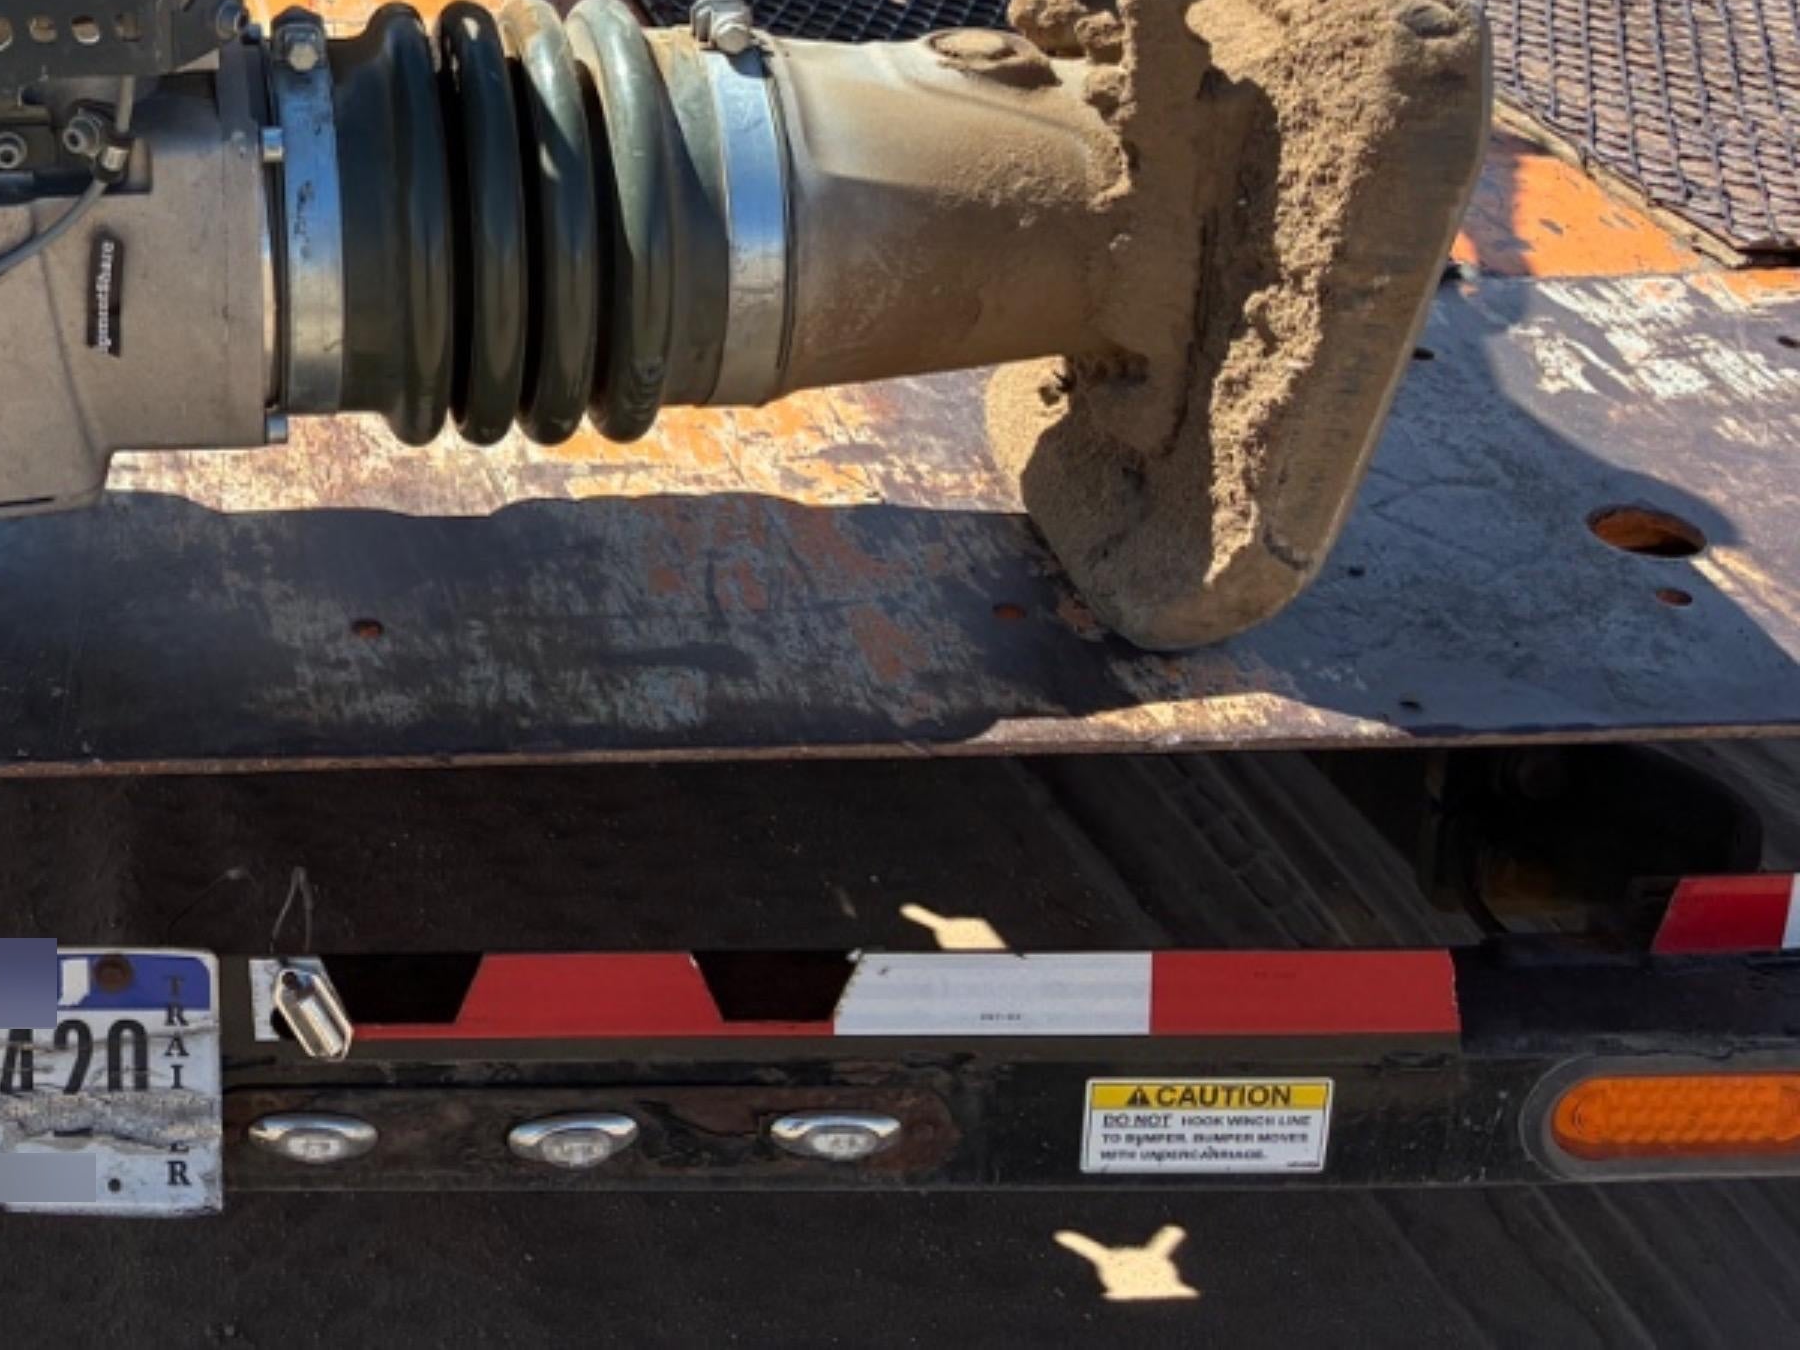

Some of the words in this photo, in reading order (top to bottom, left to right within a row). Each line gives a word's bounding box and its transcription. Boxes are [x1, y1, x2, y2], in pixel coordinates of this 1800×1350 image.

[1156, 1084, 1292, 1108] CAUTION
[1103, 1114, 1129, 1128] DO
[1134, 1113, 1174, 1128] NOT
[1181, 1115, 1223, 1127] HOOK
[1226, 1115, 1276, 1127] WINCH
[1277, 1114, 1313, 1127] LINE
[1102, 1132, 1122, 1144] TO
[1193, 1132, 1255, 1144] BUMPER
